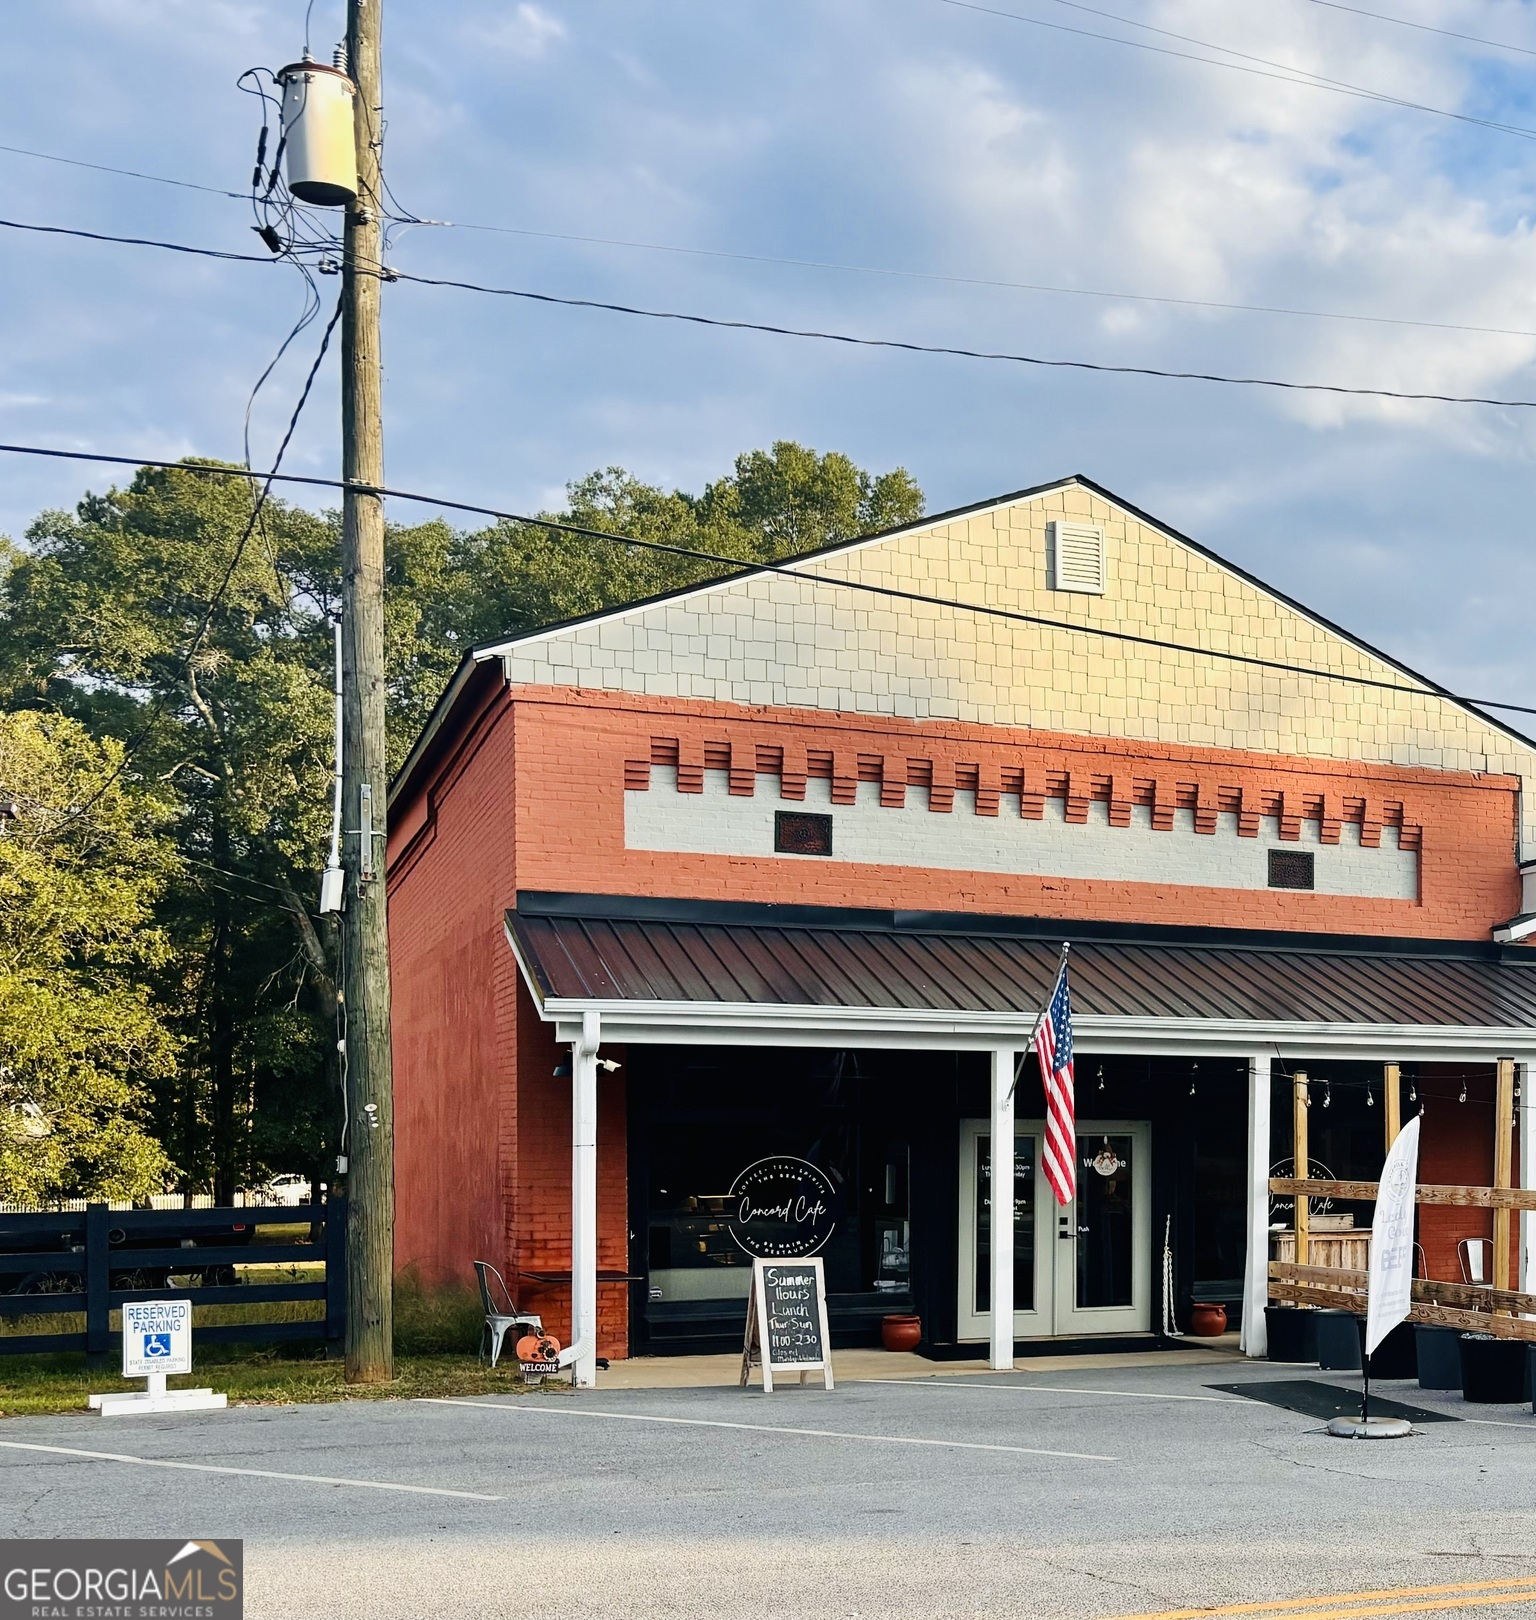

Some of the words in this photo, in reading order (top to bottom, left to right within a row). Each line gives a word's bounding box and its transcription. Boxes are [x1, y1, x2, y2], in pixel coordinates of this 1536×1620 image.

[739, 1196, 793, 1224] Concord
[795, 1195, 827, 1226] Cafe
[768, 1268, 815, 1287] Summer
[128, 1306, 186, 1320] RESERVED
[772, 1302, 809, 1317] Lunch
[133, 1319, 181, 1334] PARKING
[520, 1363, 557, 1372] WELCOME
